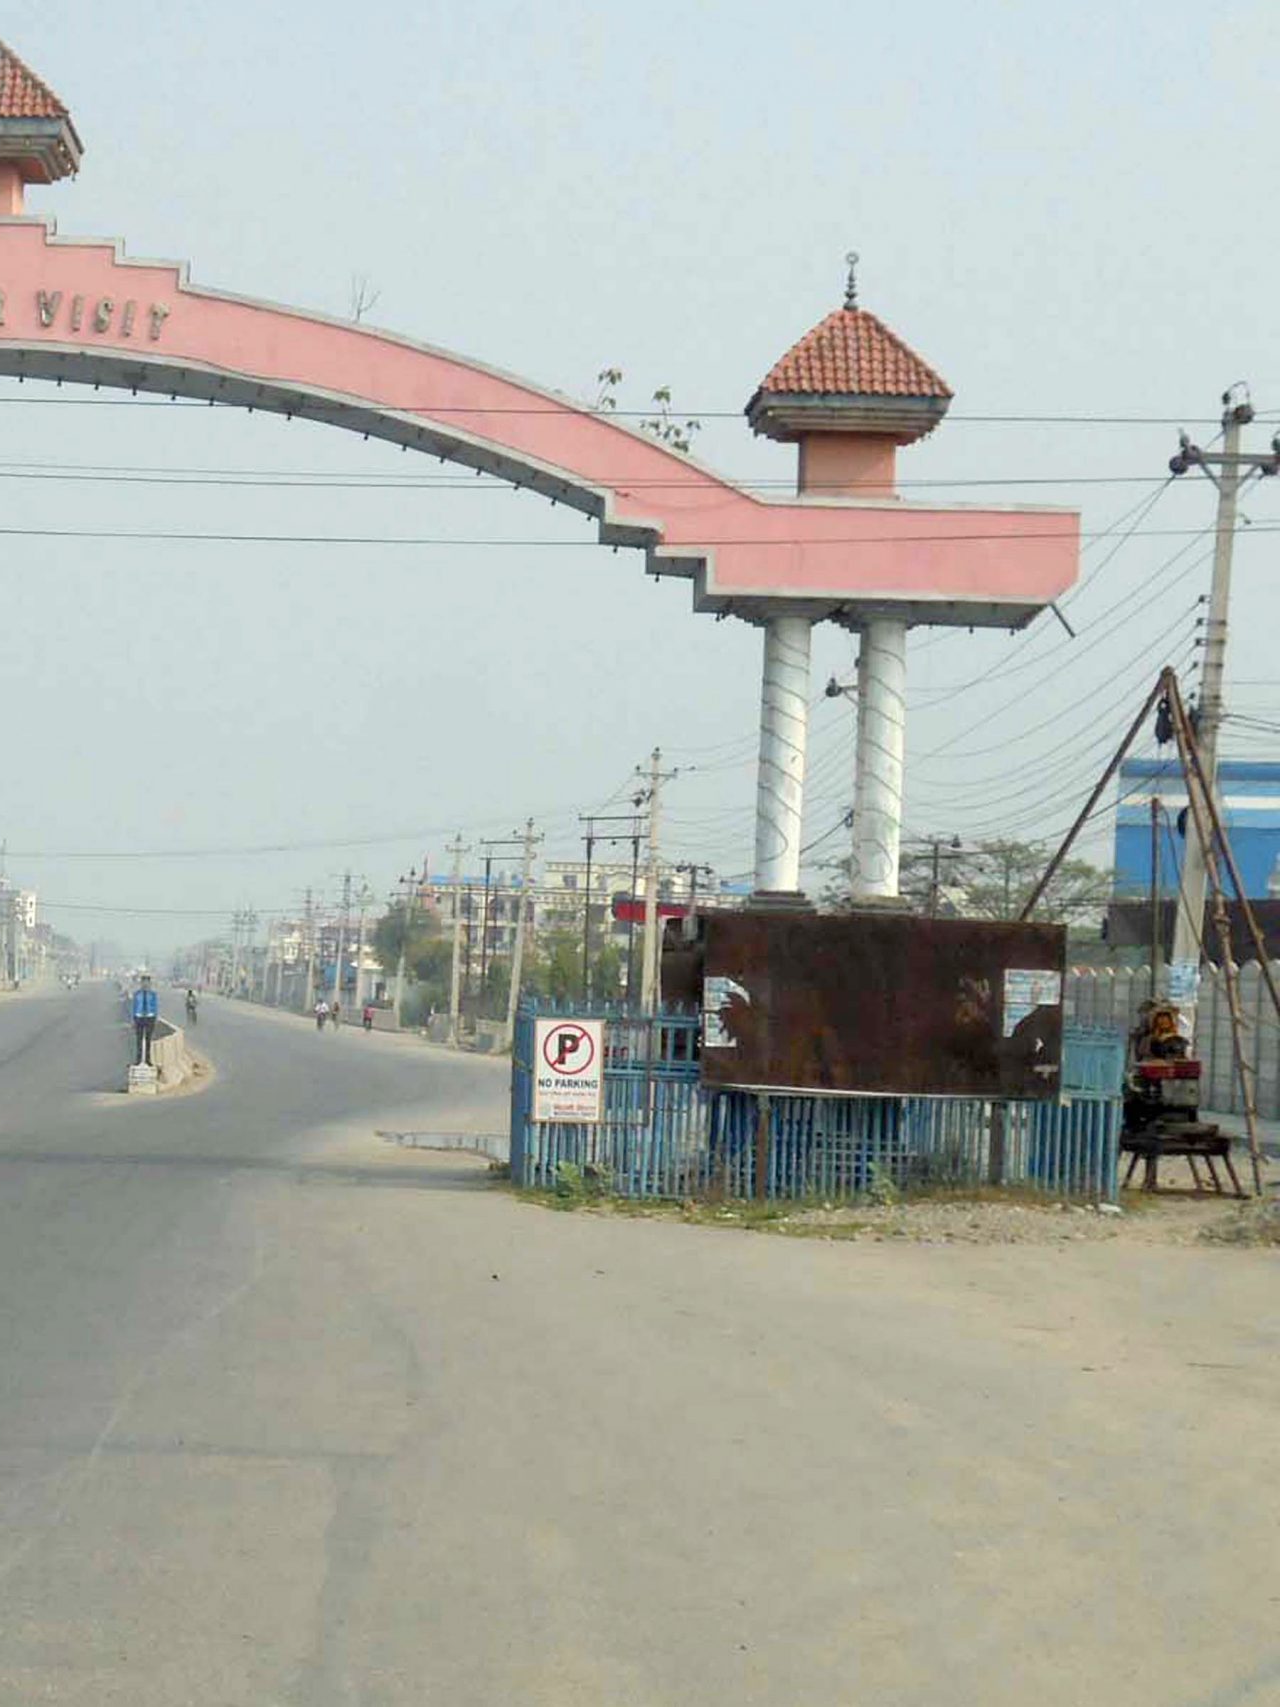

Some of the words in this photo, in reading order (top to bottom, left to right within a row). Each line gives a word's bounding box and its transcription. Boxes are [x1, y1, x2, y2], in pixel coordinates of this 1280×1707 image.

[35, 290, 170, 340] VISIT
[558, 1033, 580, 1065] P
[538, 1078, 552, 1088] NO
[555, 1079, 598, 1089] PARKING
